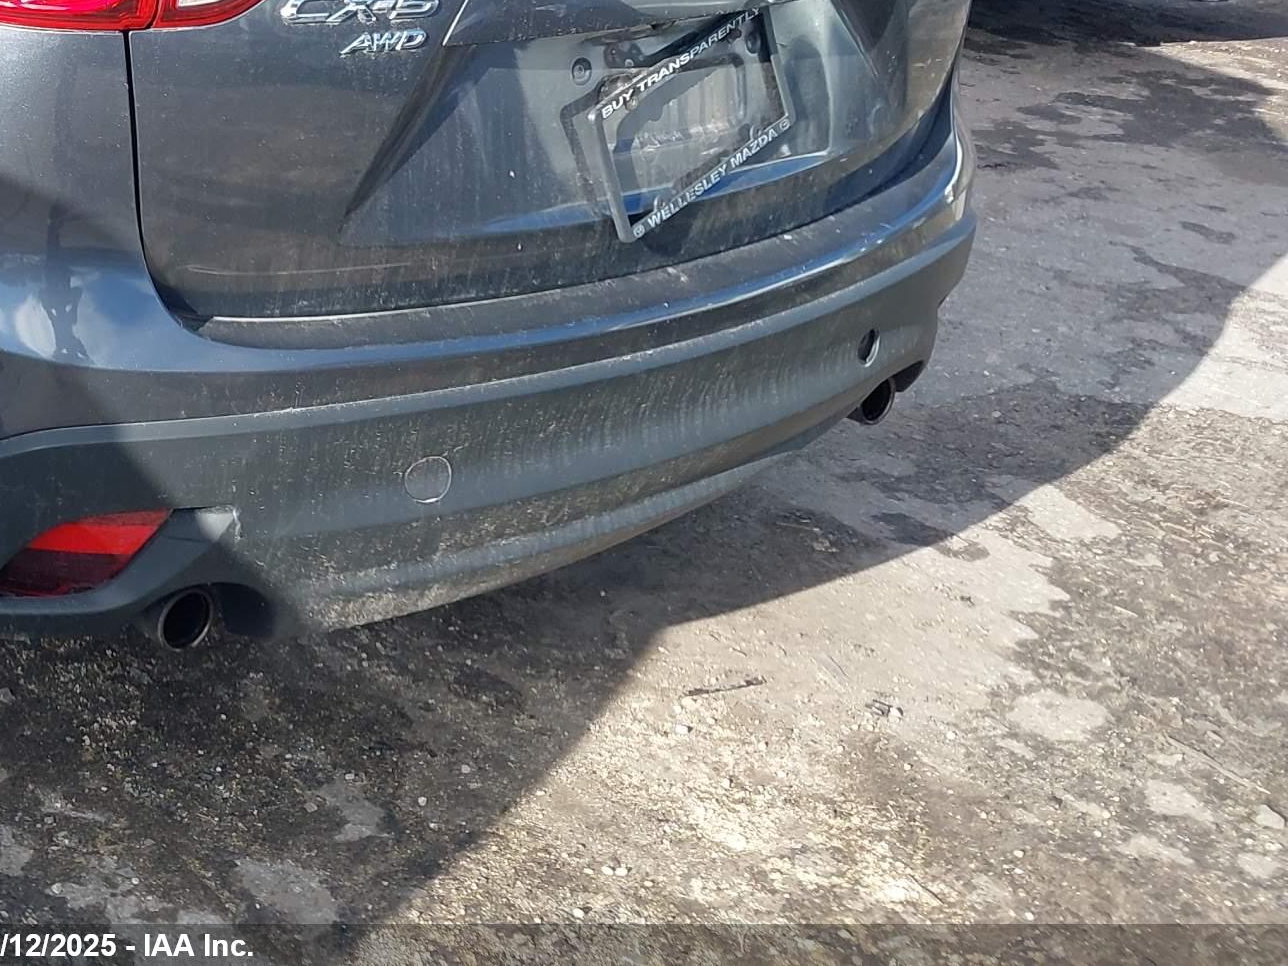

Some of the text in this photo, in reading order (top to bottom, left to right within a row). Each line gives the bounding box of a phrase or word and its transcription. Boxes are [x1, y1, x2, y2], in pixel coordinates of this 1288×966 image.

[339, 29, 428, 58] AWD
[601, 7, 762, 119] BUY TRANSPARENTLY
[647, 129, 779, 228] WELLESLEY MAZDA
